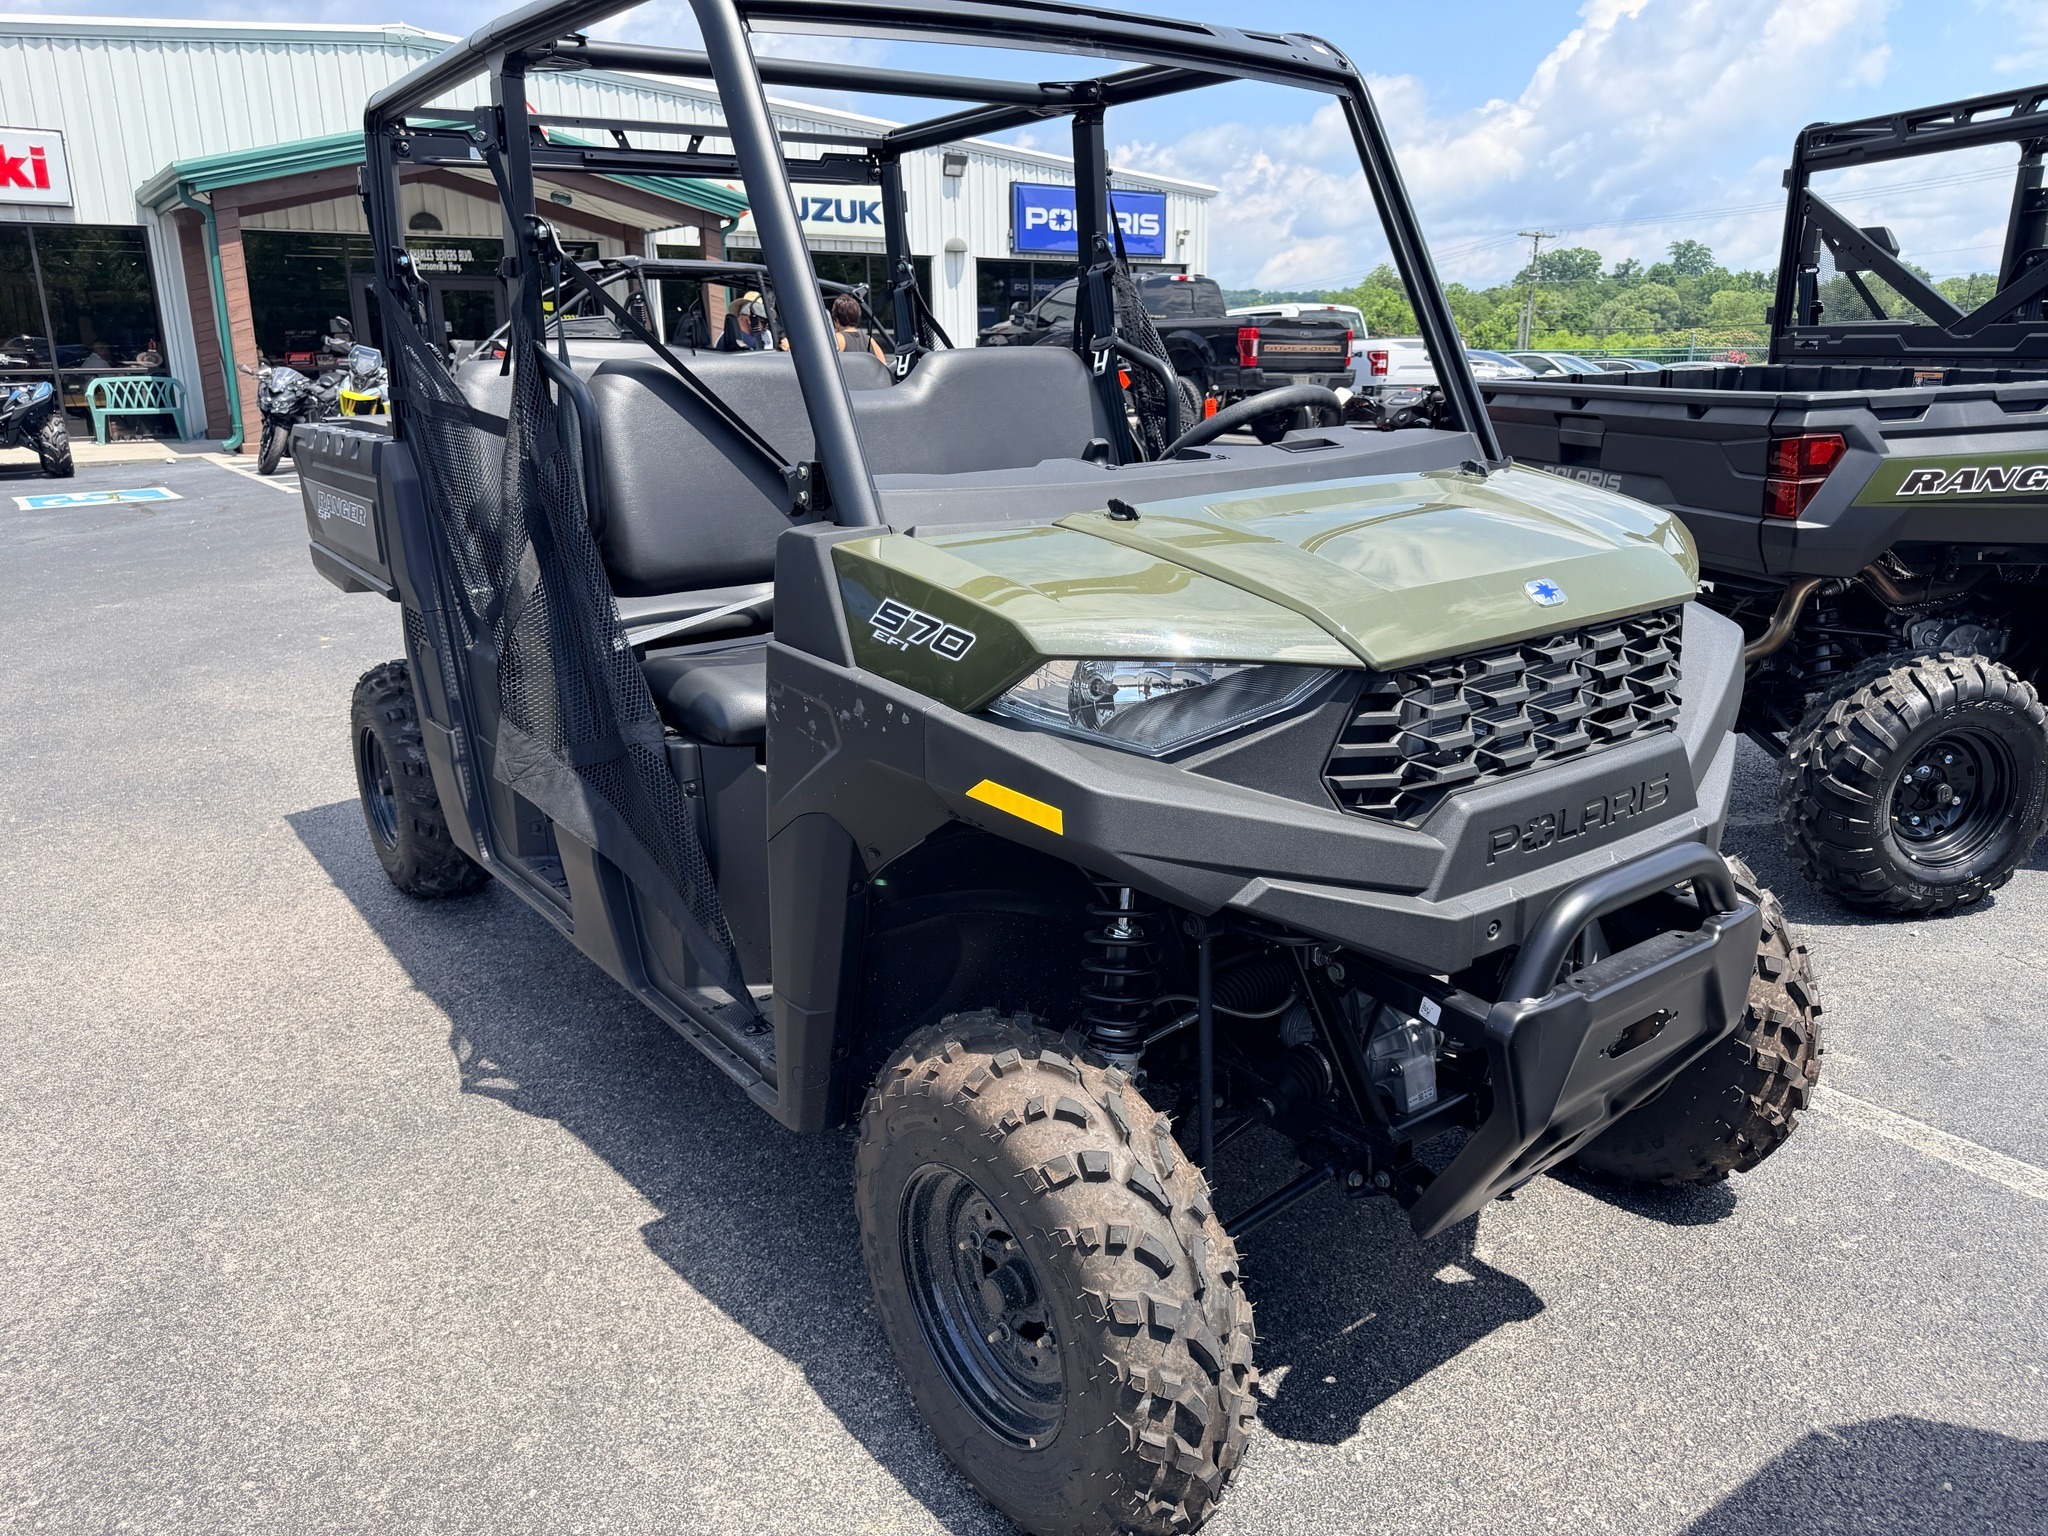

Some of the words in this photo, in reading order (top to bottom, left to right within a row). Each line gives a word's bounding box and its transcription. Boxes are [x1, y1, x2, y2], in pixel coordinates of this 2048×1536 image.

[1025, 207, 1160, 236] PORIS
[1014, 283, 1055, 292] POARIS
[1896, 466, 2048, 496] RANG
[318, 490, 367, 527] RANGER
[318, 509, 331, 520] SP
[869, 598, 977, 661] 570
[872, 630, 909, 651] EFI
[1486, 772, 1670, 867] POLARIS
